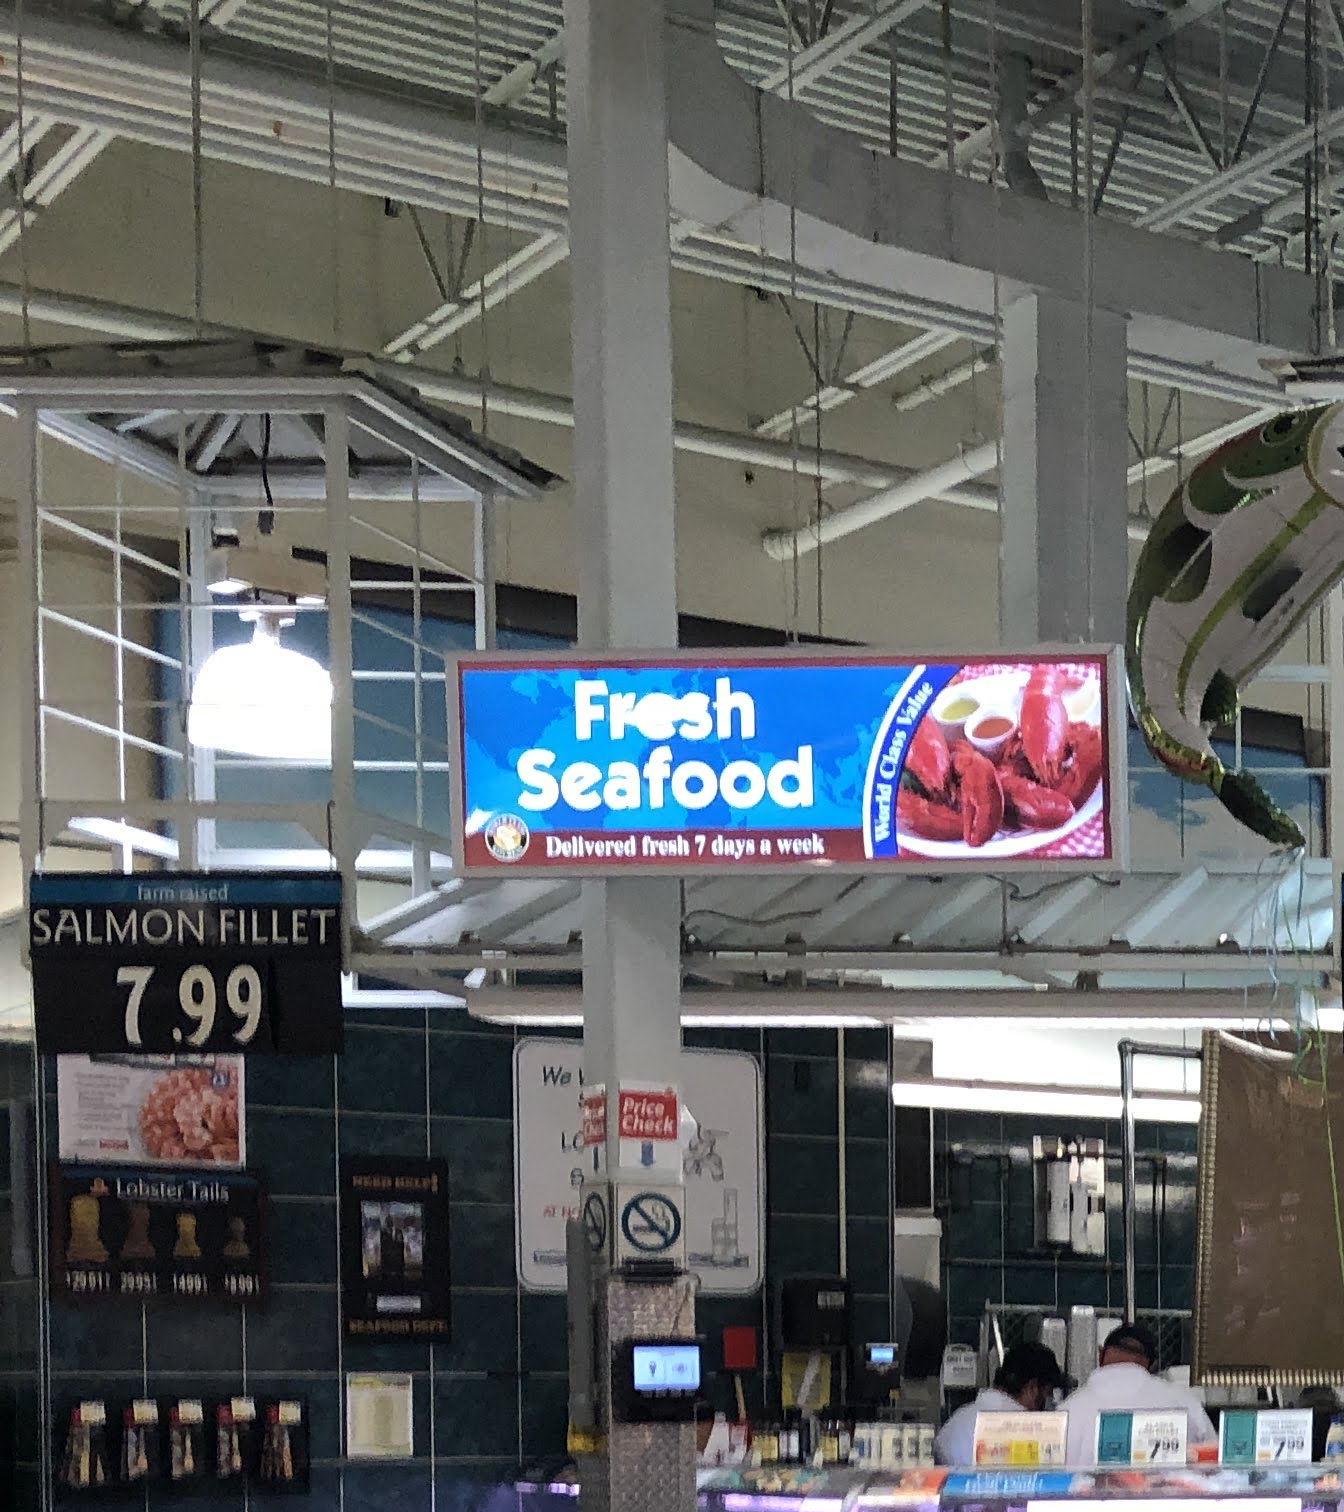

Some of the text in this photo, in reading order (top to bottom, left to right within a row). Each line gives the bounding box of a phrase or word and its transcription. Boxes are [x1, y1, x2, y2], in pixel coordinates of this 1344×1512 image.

[573, 677, 756, 741] Fresh
[874, 682, 933, 843] World Class Value
[516, 744, 814, 811] Seafood
[546, 835, 636, 858] Delivered
[642, 834, 690, 857] fresh
[694, 835, 707, 857] 7
[711, 834, 756, 860] days
[760, 840, 772, 856] a
[776, 833, 825, 856] week
[138, 884, 229, 902] farm raised
[33, 908, 336, 947] SALMON FILLET
[622, 1098, 666, 1117] Price
[621, 1114, 676, 1135] Check
[116, 1177, 230, 1202] Lobster Tails
